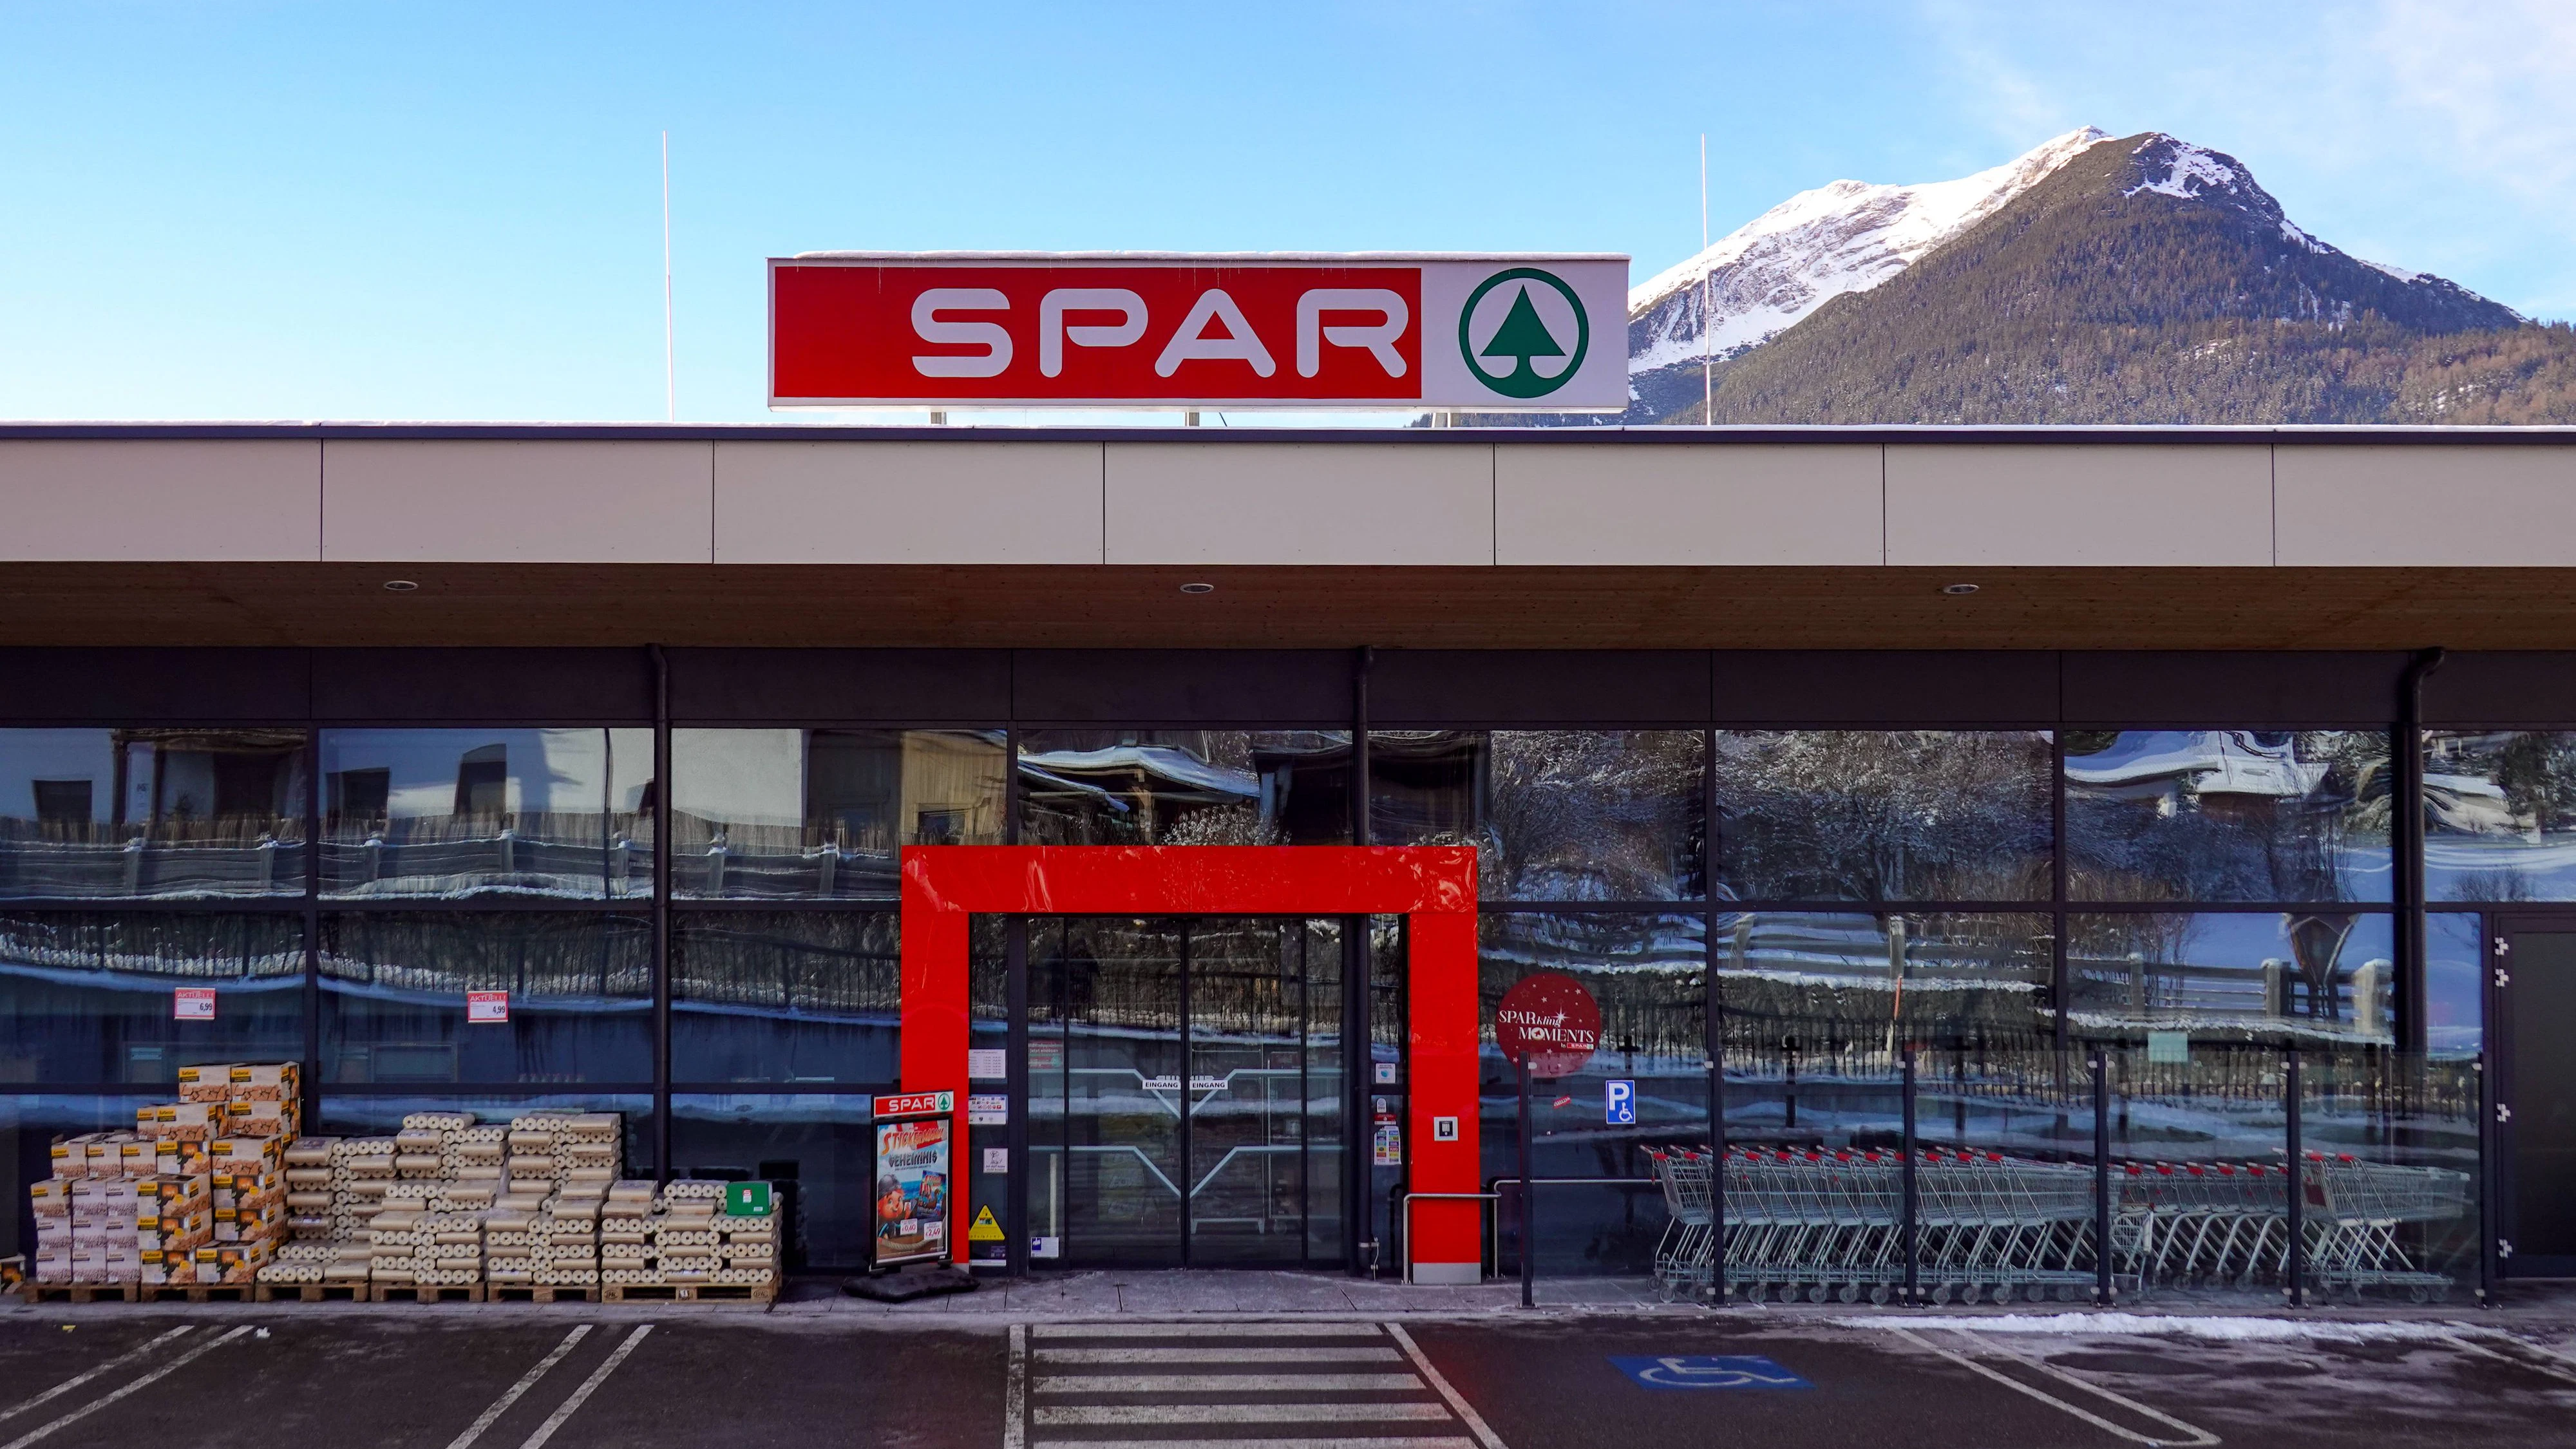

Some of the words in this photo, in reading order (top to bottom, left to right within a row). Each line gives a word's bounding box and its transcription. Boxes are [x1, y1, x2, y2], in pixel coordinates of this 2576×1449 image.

[911, 287, 1408, 379] SPAR
[200, 1003, 213, 1012] 6,99
[492, 1005, 506, 1015] 4,99
[1499, 1010, 1562, 1028] SPARkling
[1518, 1027, 1595, 1043] MOMENTS
[888, 1096, 935, 1112] SPAR
[1608, 1083, 1631, 1111] P
